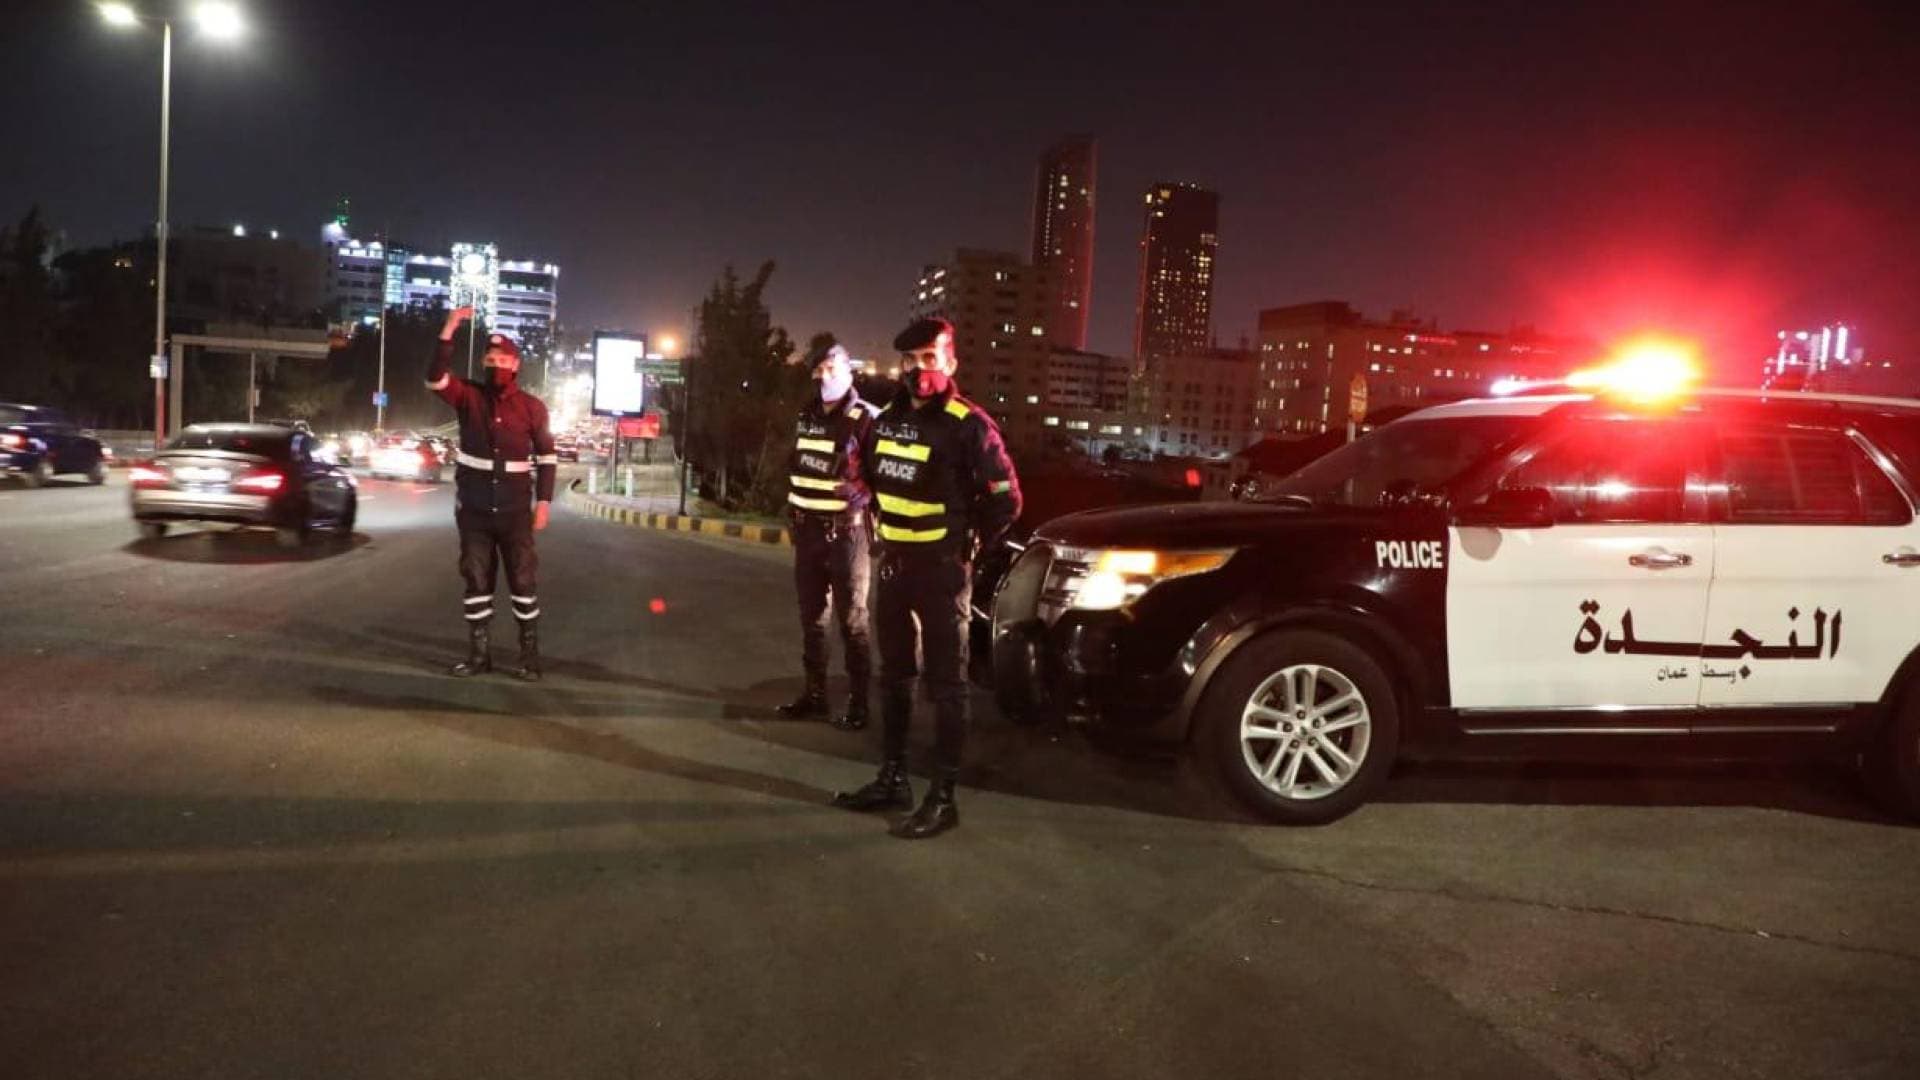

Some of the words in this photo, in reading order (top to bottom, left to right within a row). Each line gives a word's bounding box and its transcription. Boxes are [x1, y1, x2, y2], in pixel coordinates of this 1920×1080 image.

[800, 453, 831, 473] POLICE
[878, 458, 917, 480] POLICE
[1375, 541, 1444, 568] POLICE
[1573, 599, 1842, 660] النجدة
[1657, 665, 1688, 681] عمان
[1700, 664, 1737, 684] وسط
